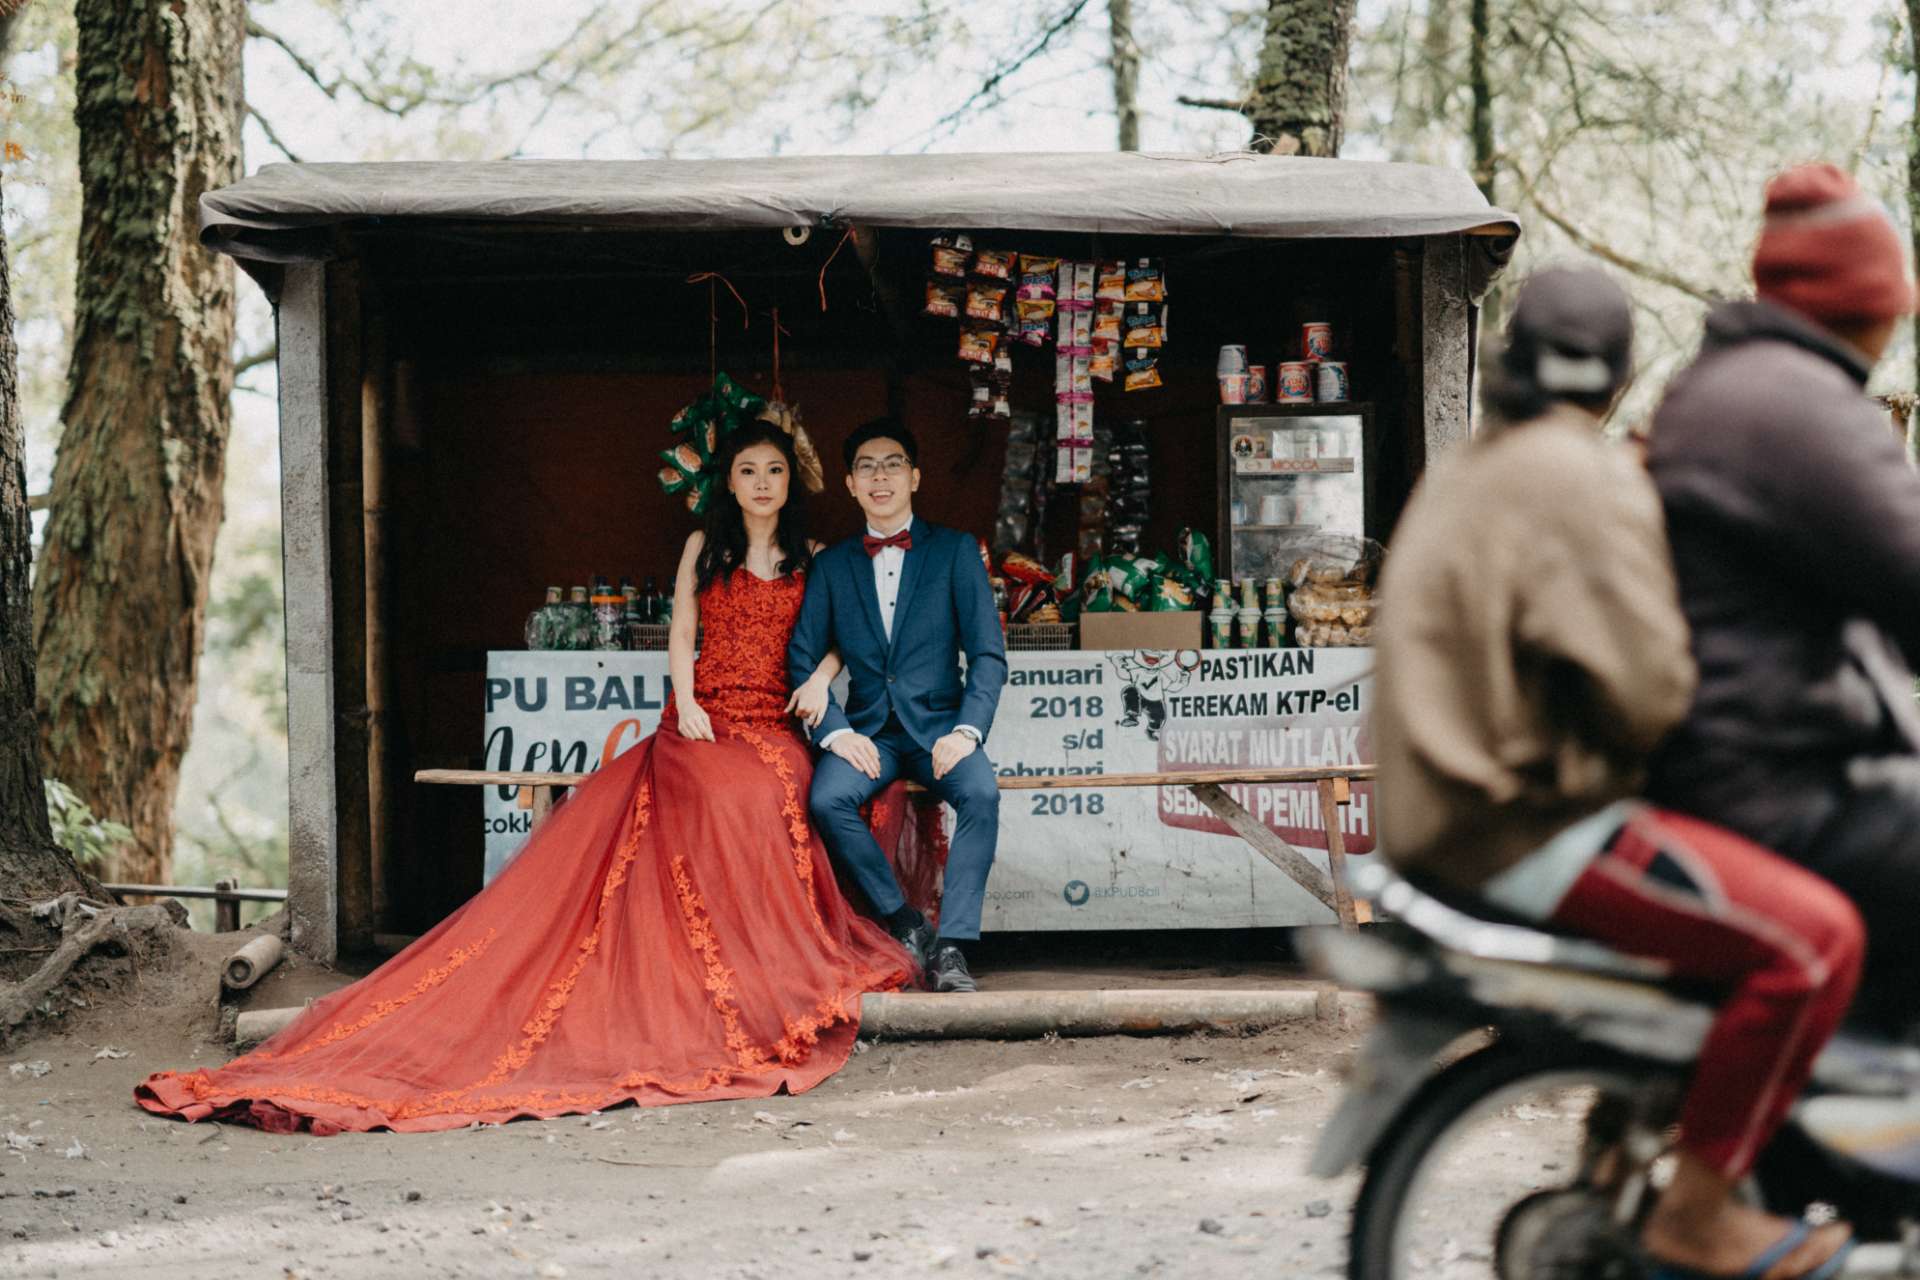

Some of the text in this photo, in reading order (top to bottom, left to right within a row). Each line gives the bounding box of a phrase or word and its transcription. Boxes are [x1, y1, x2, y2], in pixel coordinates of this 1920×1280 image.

[1003, 663, 1103, 686] anuari
[1201, 649, 1314, 682] PASTIKAN
[1030, 696, 1104, 718] 2018
[1169, 684, 1359, 718] TEREKAM KTP-el
[1062, 728, 1103, 750] s/d
[1164, 726, 1361, 767] SYARAT MUTLAK
[1030, 793, 1104, 816] 2018
[1258, 787, 1369, 836] PEMIIH
